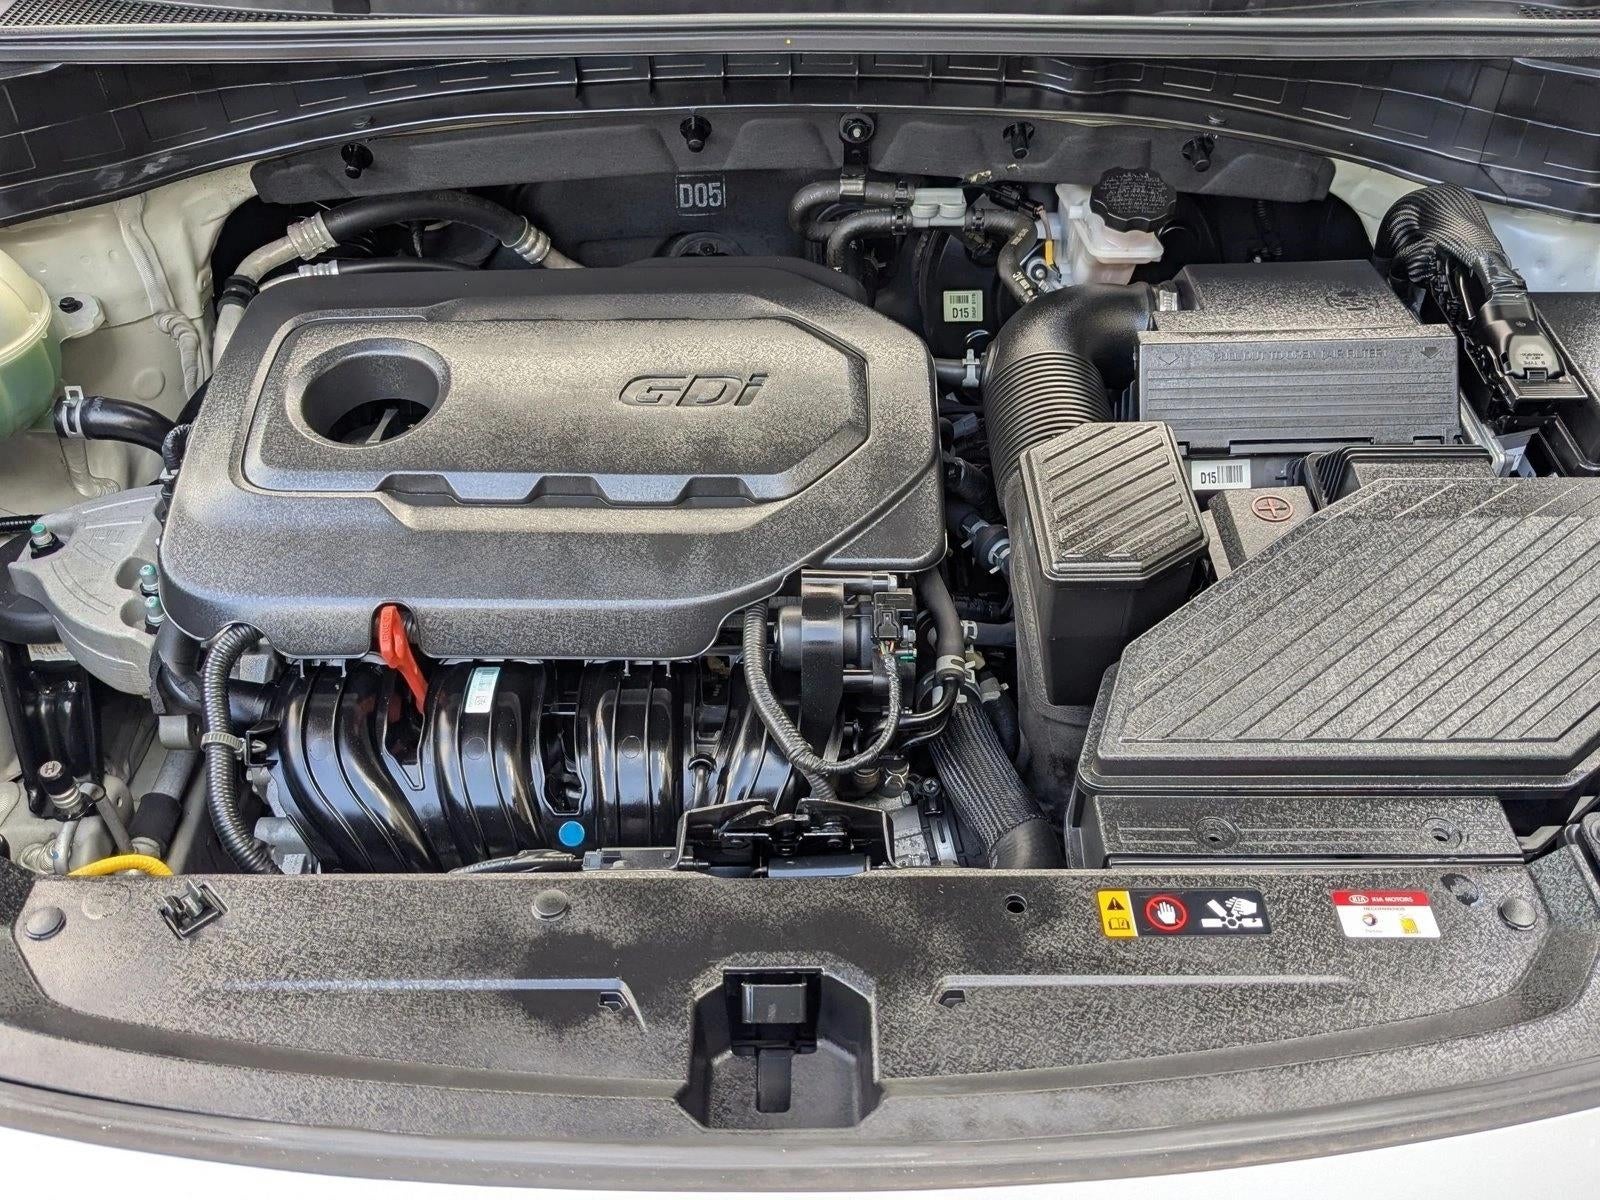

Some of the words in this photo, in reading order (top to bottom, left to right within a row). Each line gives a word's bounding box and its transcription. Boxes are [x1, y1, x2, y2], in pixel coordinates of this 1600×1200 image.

[679, 182, 721, 208] D05
[952, 307, 970, 319] D15
[1200, 471, 1217, 484] D15
